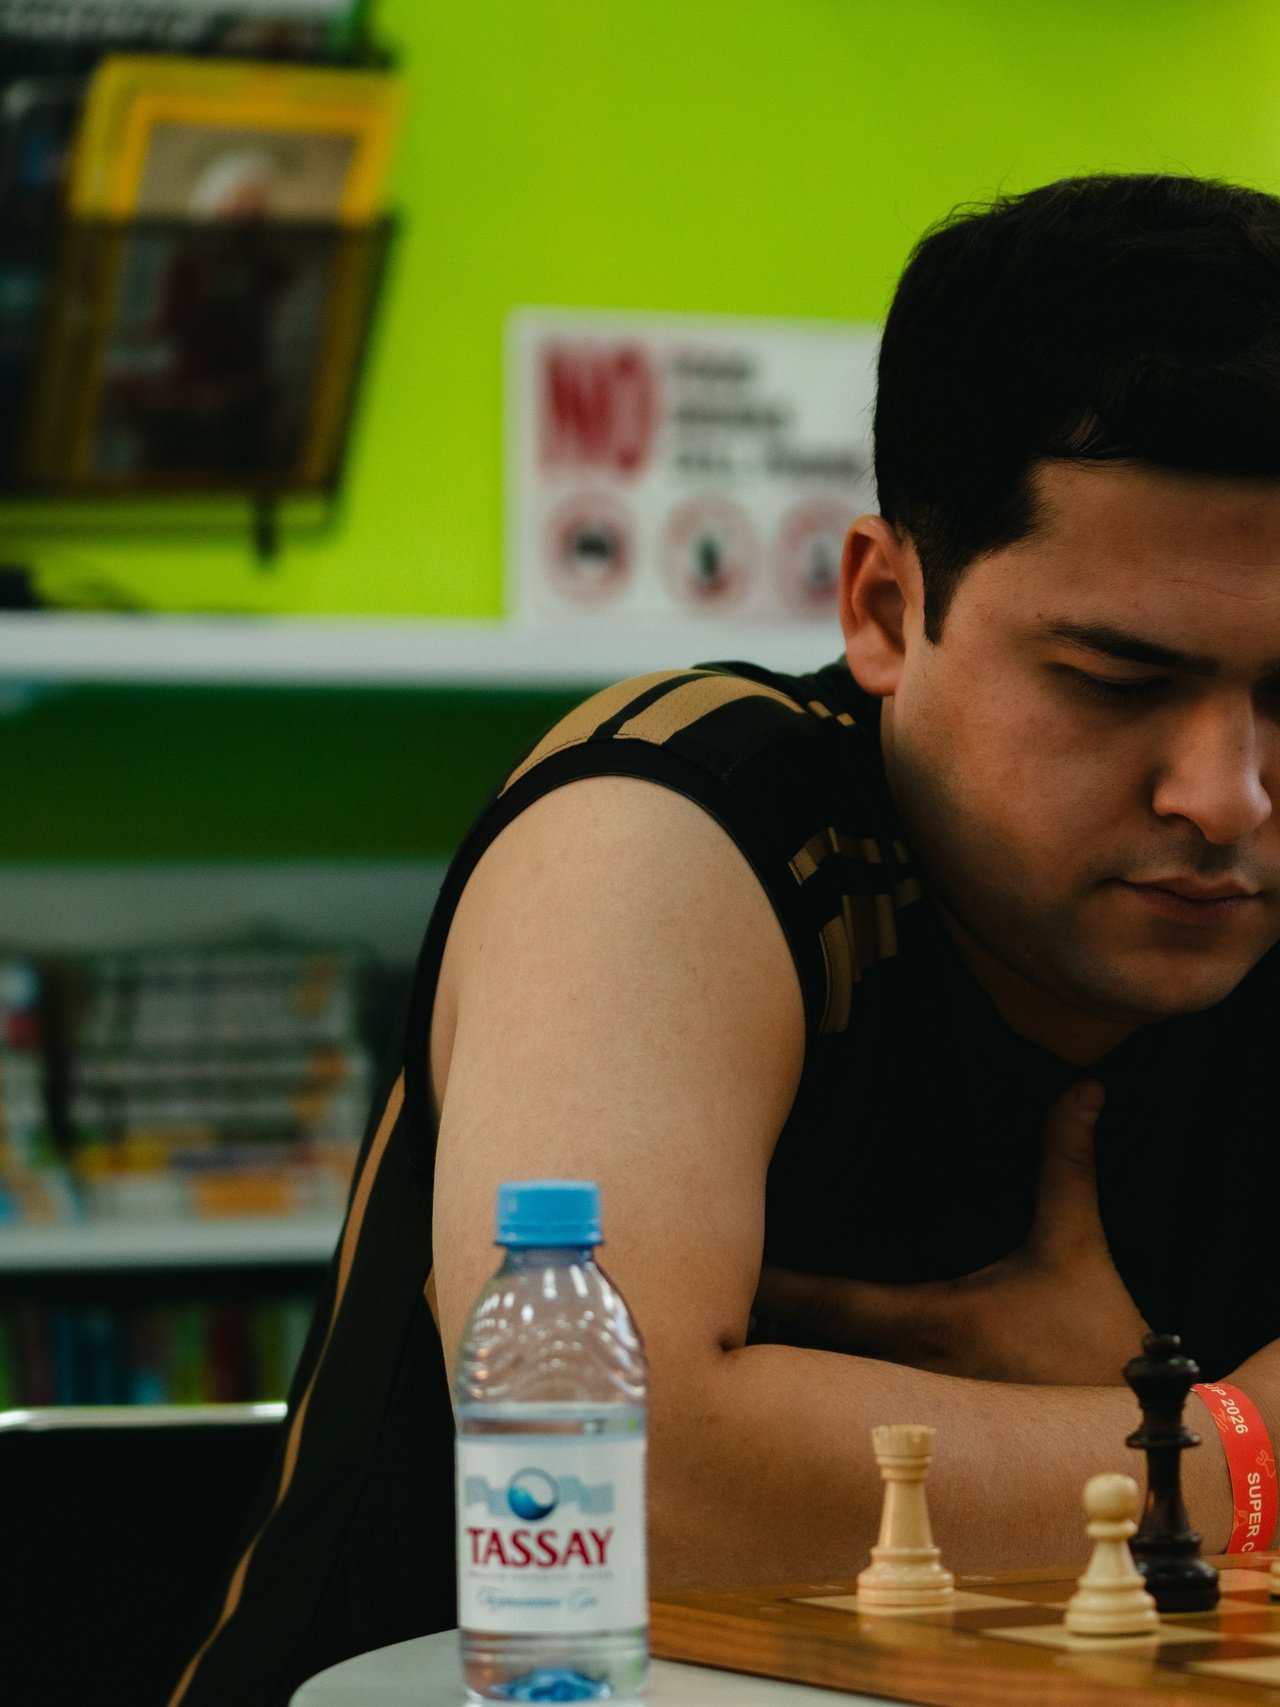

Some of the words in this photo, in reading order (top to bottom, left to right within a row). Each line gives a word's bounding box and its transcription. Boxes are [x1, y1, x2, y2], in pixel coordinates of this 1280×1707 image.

[542, 340, 656, 480] NO
[1220, 1398, 1249, 1434] 2026
[1247, 1472, 1262, 1538] SUPER
[466, 1527, 614, 1568] TASSAY
